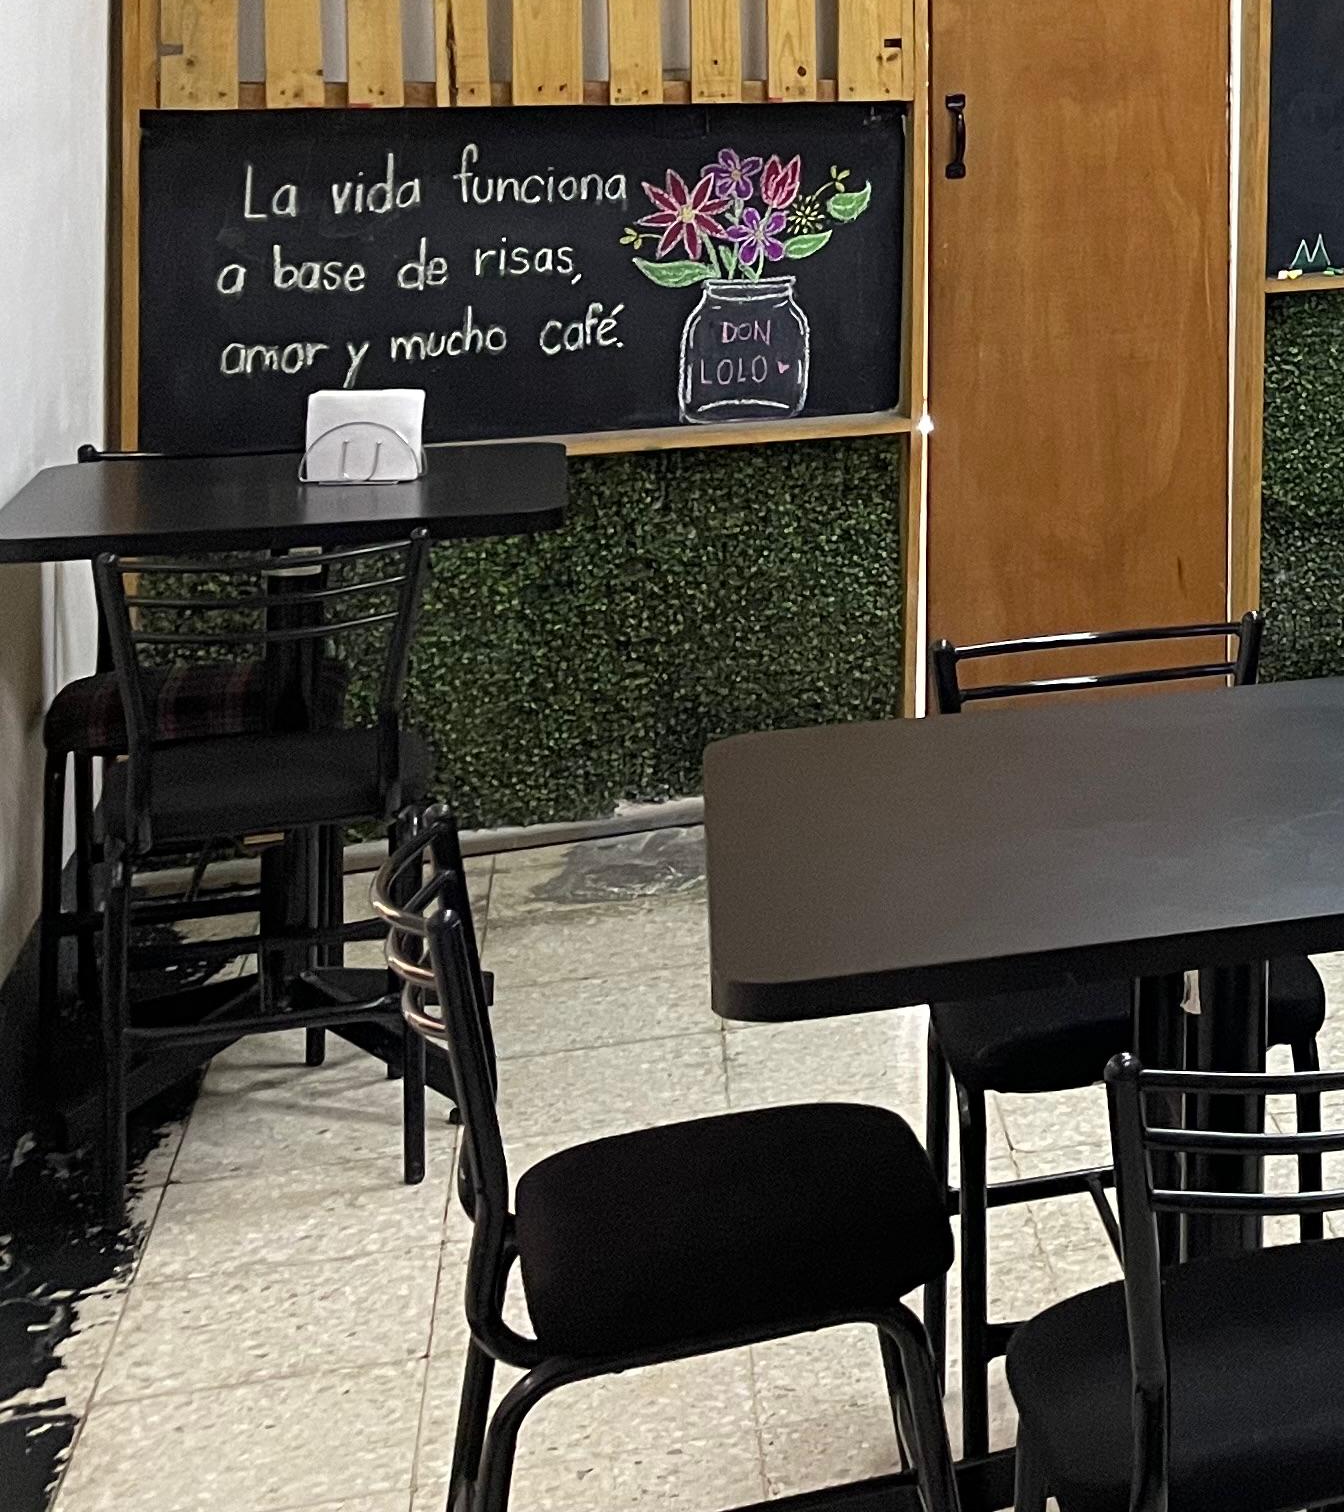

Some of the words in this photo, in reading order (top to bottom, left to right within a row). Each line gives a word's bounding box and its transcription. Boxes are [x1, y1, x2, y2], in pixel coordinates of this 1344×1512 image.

[243, 164, 299, 221] La
[331, 151, 422, 217] vida
[452, 143, 629, 207] funciona
[215, 260, 247, 295] a
[271, 245, 367, 293] base
[397, 237, 449, 291] de
[474, 236, 584, 286] risas,
[219, 338, 326, 378] amor
[342, 339, 371, 388] y
[389, 305, 508, 362] mucho
[538, 303, 626, 356] café.
[720, 318, 772, 347] DON
[699, 353, 769, 387] LOLO
